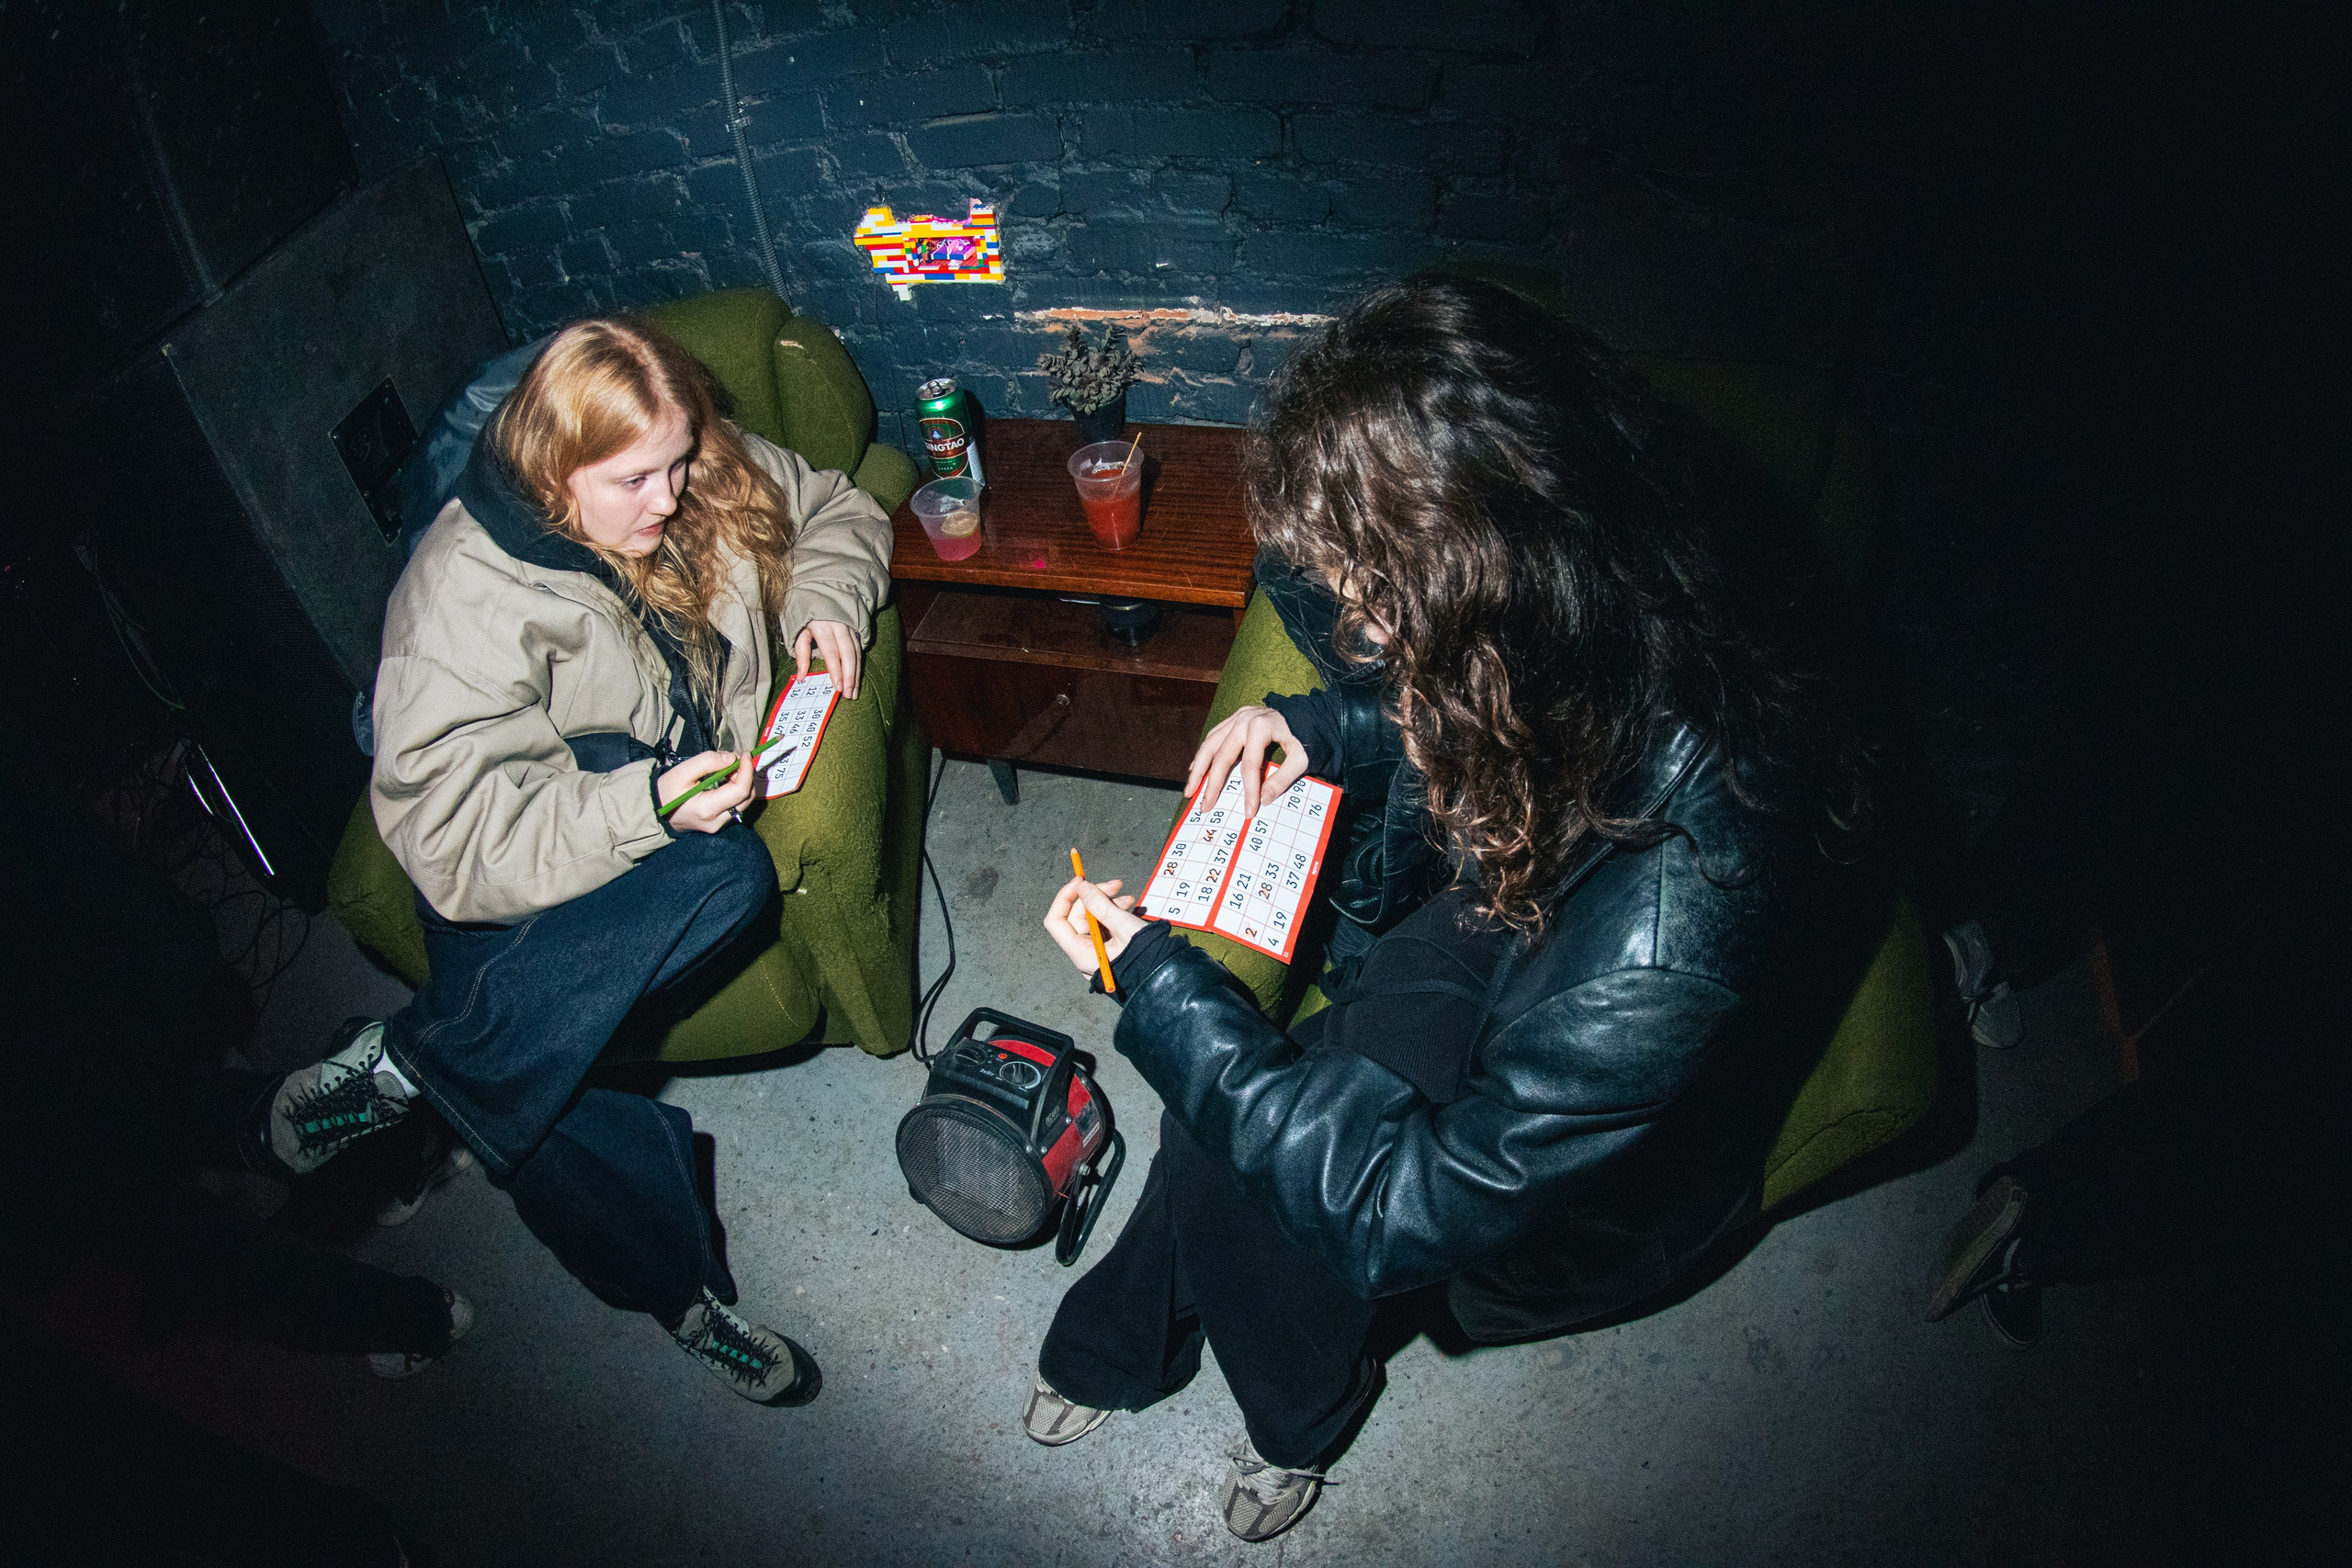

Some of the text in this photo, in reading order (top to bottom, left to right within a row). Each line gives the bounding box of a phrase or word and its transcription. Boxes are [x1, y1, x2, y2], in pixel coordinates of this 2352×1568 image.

[925, 438, 965, 452] SINGTAO
[790, 688, 801, 697] 16
[806, 687, 817, 696] 12
[779, 712, 789, 722] 35
[795, 710, 807, 720] 33
[801, 685, 833, 747] 10 30 40 52
[774, 726, 785, 735] 47
[789, 724, 800, 734] 46
[775, 768, 786, 779] 75
[1169, 779, 1241, 915] 5 19 44 58 71
[1163, 862, 1179, 876] 28
[1171, 843, 1187, 857] 30
[1198, 831, 1238, 901] 18 22 37 46
[1229, 820, 1269, 909] 16 21 40 57
[1245, 780, 1306, 938] 2 28 33 70 90
[1270, 804, 1323, 946] 4 19 37 48 76
